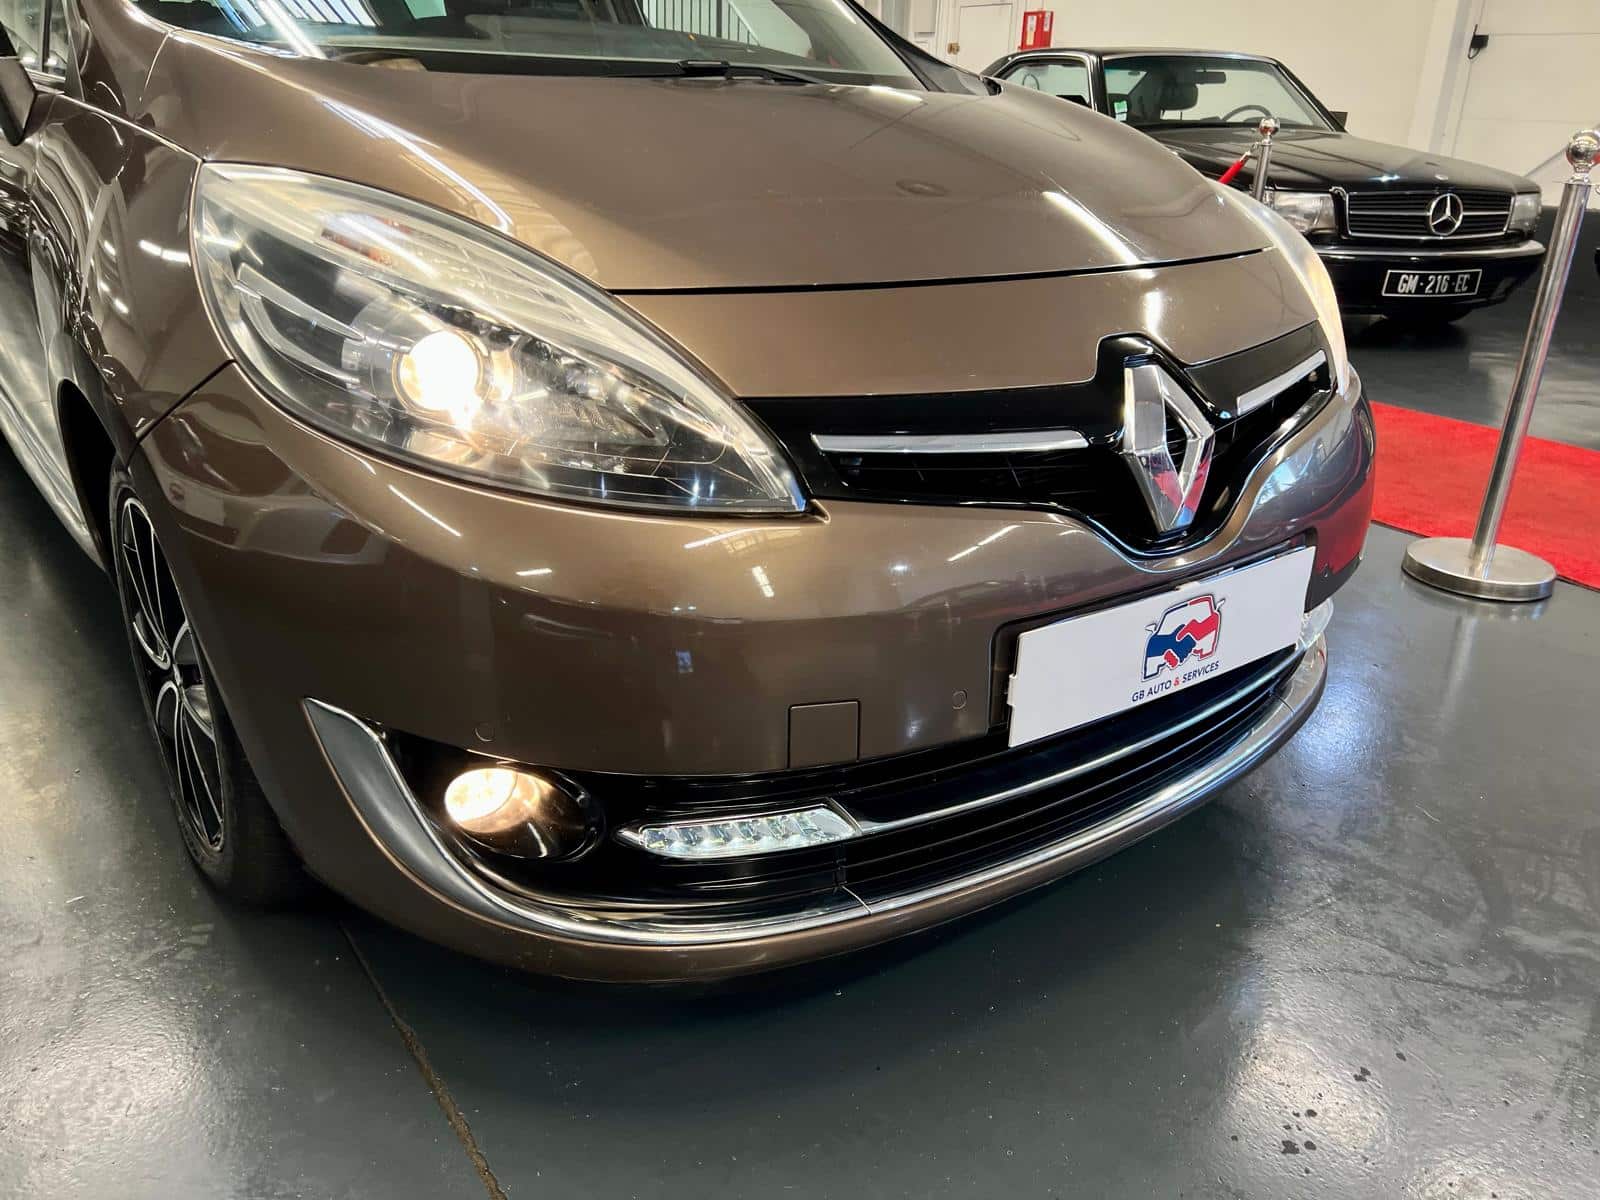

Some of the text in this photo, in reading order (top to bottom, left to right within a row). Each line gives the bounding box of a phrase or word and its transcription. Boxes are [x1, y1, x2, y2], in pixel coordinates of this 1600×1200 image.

[1397, 274, 1419, 293] GM
[1425, 274, 1450, 293] 216
[1131, 660, 1220, 702] GB AUTO & SERVICES
